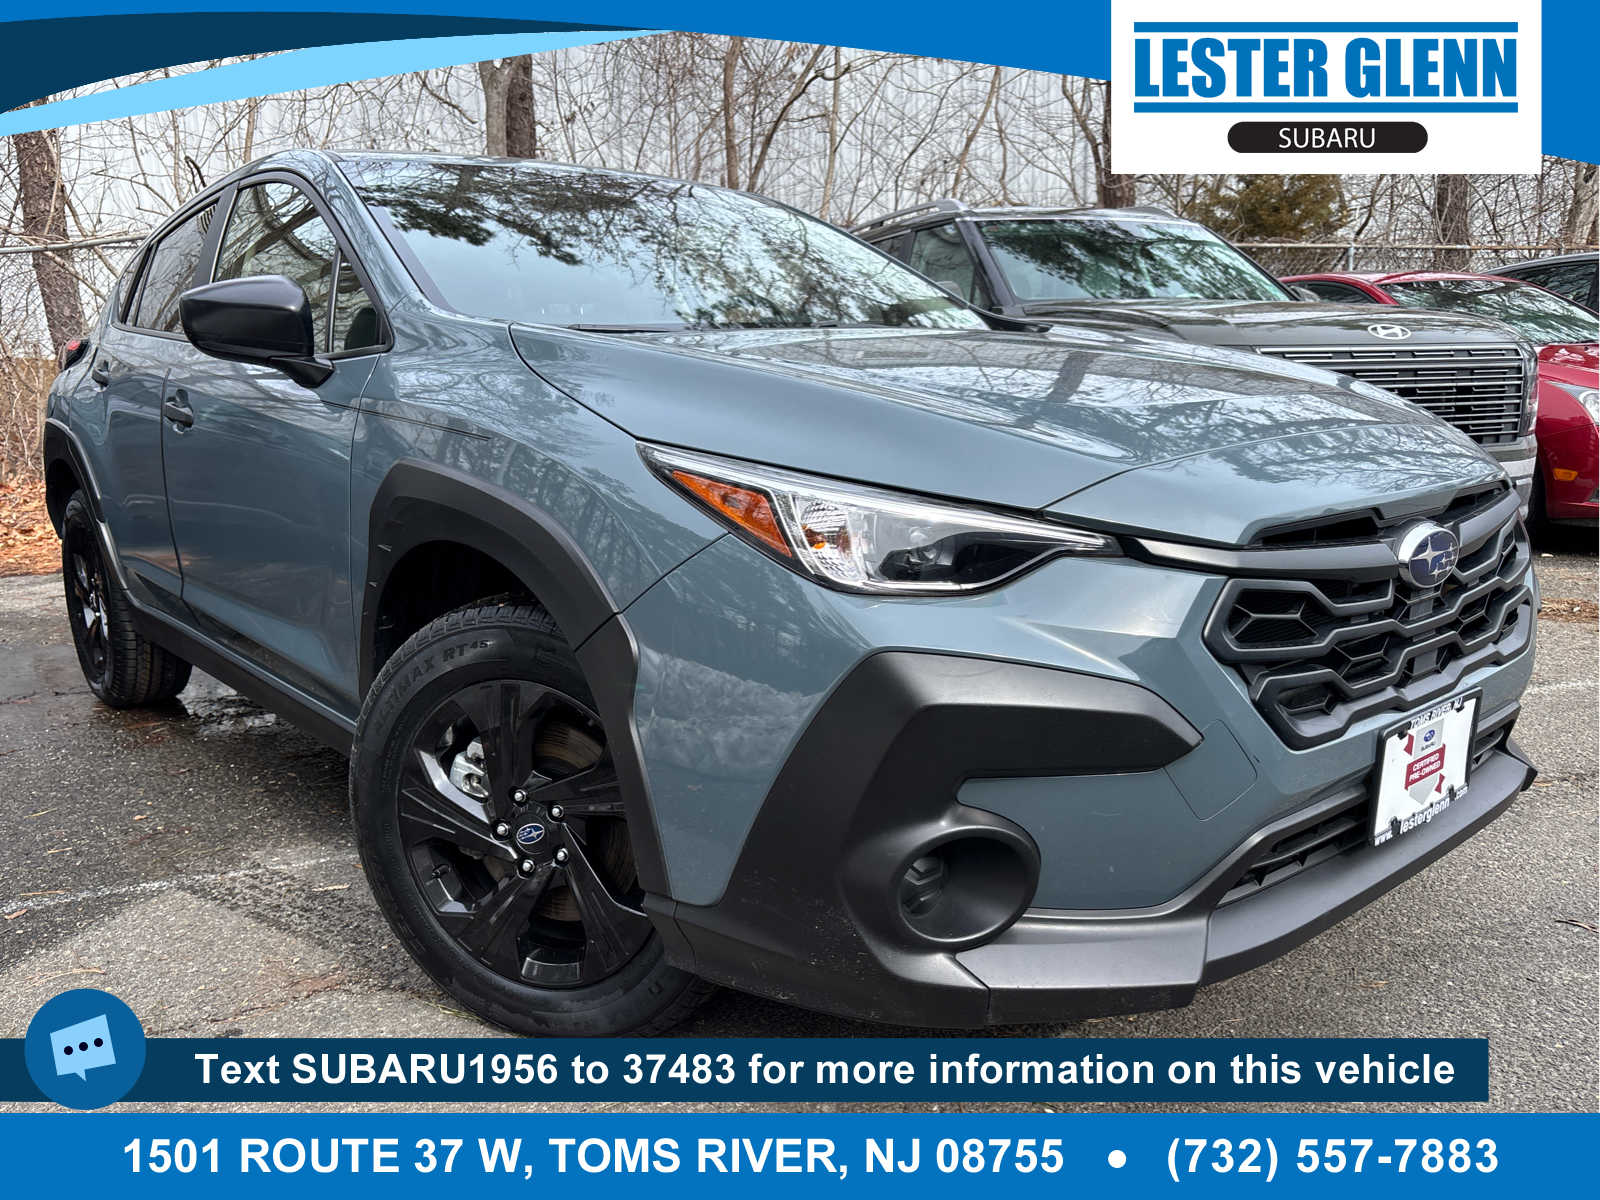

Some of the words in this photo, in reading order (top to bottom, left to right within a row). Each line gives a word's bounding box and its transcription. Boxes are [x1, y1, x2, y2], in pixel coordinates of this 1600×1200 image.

[1409, 761, 1441, 782] PRE-OWNED
[1412, 752, 1440, 771] CERTIFIED
[1400, 798, 1450, 835] lesterglenn
